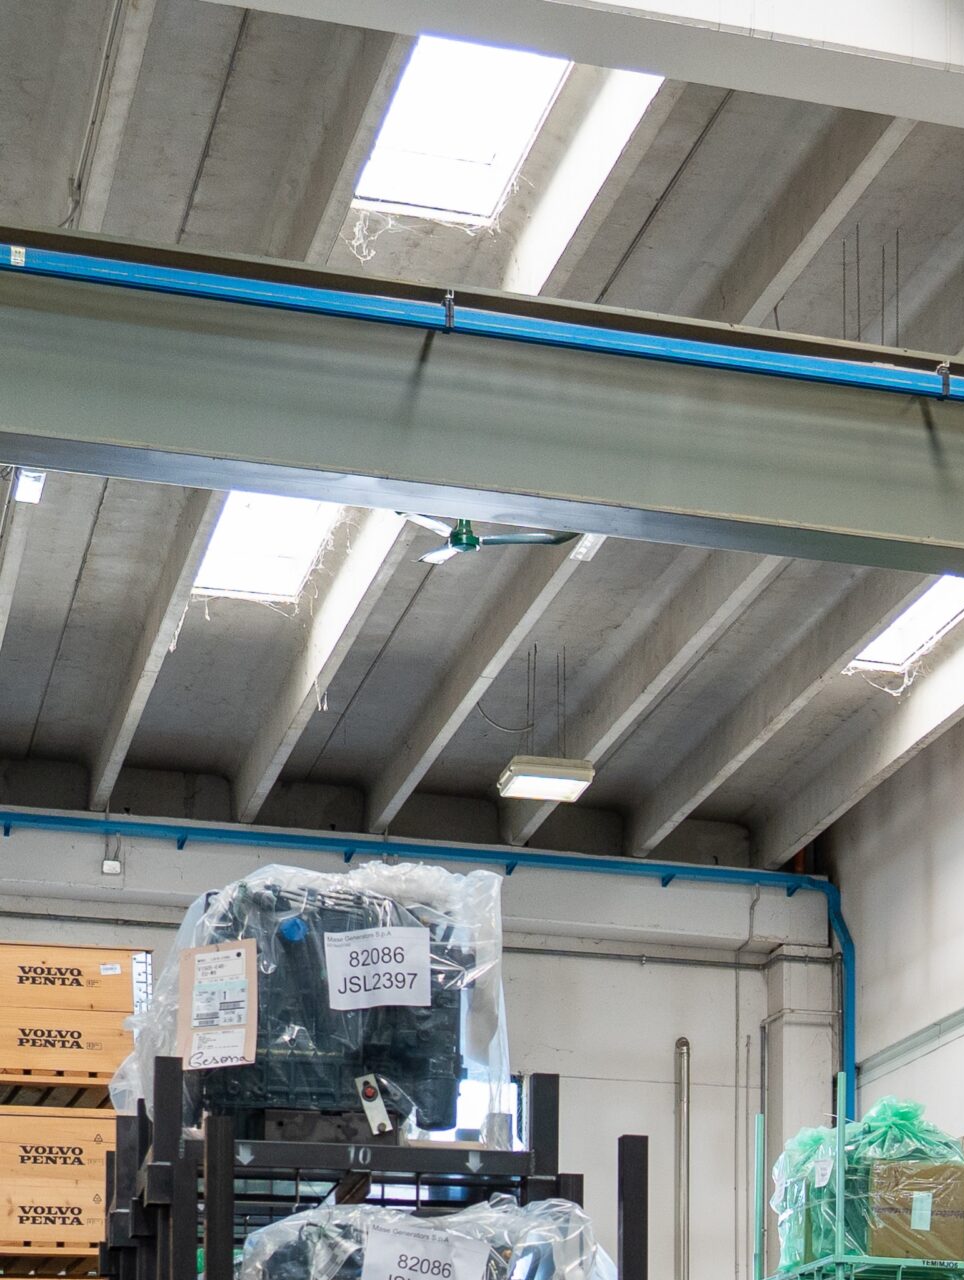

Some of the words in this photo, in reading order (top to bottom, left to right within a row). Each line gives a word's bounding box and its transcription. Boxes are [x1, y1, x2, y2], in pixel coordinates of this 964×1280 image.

[349, 946, 405, 968] 82086
[18, 966, 83, 976] VOLVO
[17, 976, 84, 987] PENTA
[337, 972, 418, 994] JSL2397
[18, 1028, 82, 1039] VOLVO
[17, 1038, 84, 1049] PENTA
[19, 1145, 83, 1155] VOLVO
[348, 1145, 372, 1165] 10
[19, 1155, 85, 1165] PENTA
[18, 1206, 82, 1215] VOLVO
[18, 1216, 84, 1225] PENTA
[397, 1254, 452, 1278] 82086
